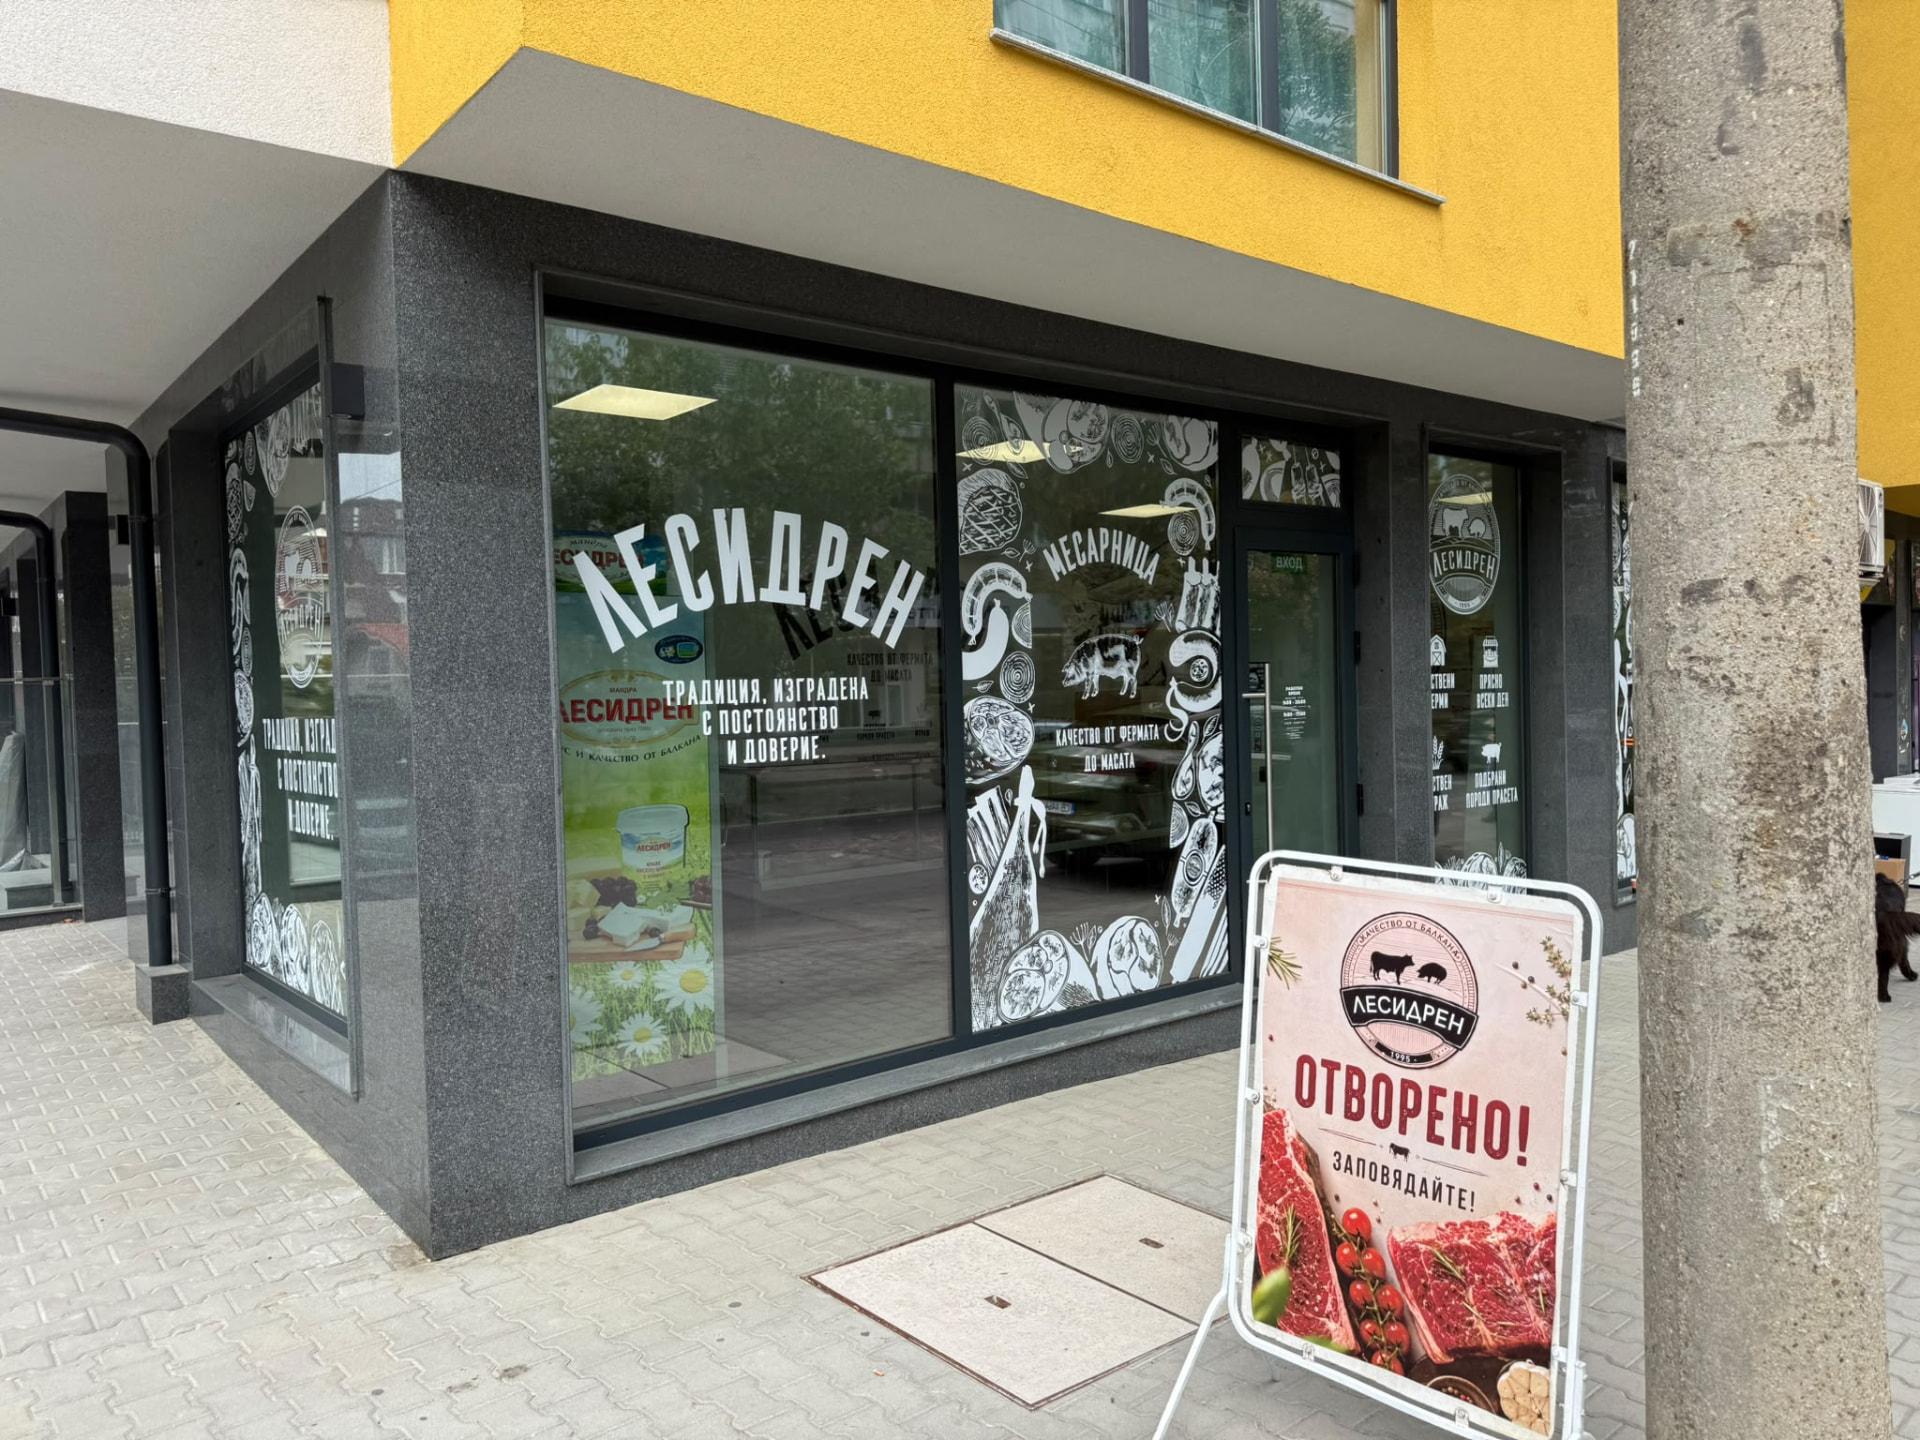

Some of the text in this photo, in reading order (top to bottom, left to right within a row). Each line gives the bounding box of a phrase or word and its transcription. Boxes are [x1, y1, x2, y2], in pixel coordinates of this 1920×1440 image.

[1042, 527, 1161, 585] МЕСАРНИЦА
[1276, 556, 1303, 572] ВХОД
[1433, 549, 1496, 580] ЛЕСИДРЕН
[573, 507, 925, 654] ЛЕСИДРЕН
[662, 676, 869, 706] ТРАДИЦИЯ, ИЗГРАДЕНА
[1479, 673, 1503, 690] ПРЯСНО
[1476, 692, 1510, 709] ВСЕКИ ДЕН
[702, 705, 839, 736] С ПОСТОЯНСТВО
[1055, 723, 1159, 747] КАЧЕСТВО ОТ ФЕРМАТА
[589, 754, 639, 763] КАЧЕСТВО
[644, 752, 656, 760] ОТ
[661, 734, 701, 756] БАЛКАНА
[727, 735, 826, 765] И ДОВЕРИЕ.
[1084, 751, 1136, 773] ДО МАСАТА
[277, 758, 283, 790] С
[1475, 770, 1507, 789] ПОДБРАНИ
[1465, 787, 1519, 809] ПОРОДИ ПРАСЕТА
[1360, 919, 1458, 958] КАЧЕСТВО ОТ БАЛКАНА
[1353, 994, 1465, 1035] ЛЕСИДРЕН
[1390, 1051, 1411, 1063] 1995
[1294, 1053, 1531, 1168] ОТВОРЕНО!
[1332, 1150, 1476, 1213] ЗАПОВЯДАЙТЕ!
